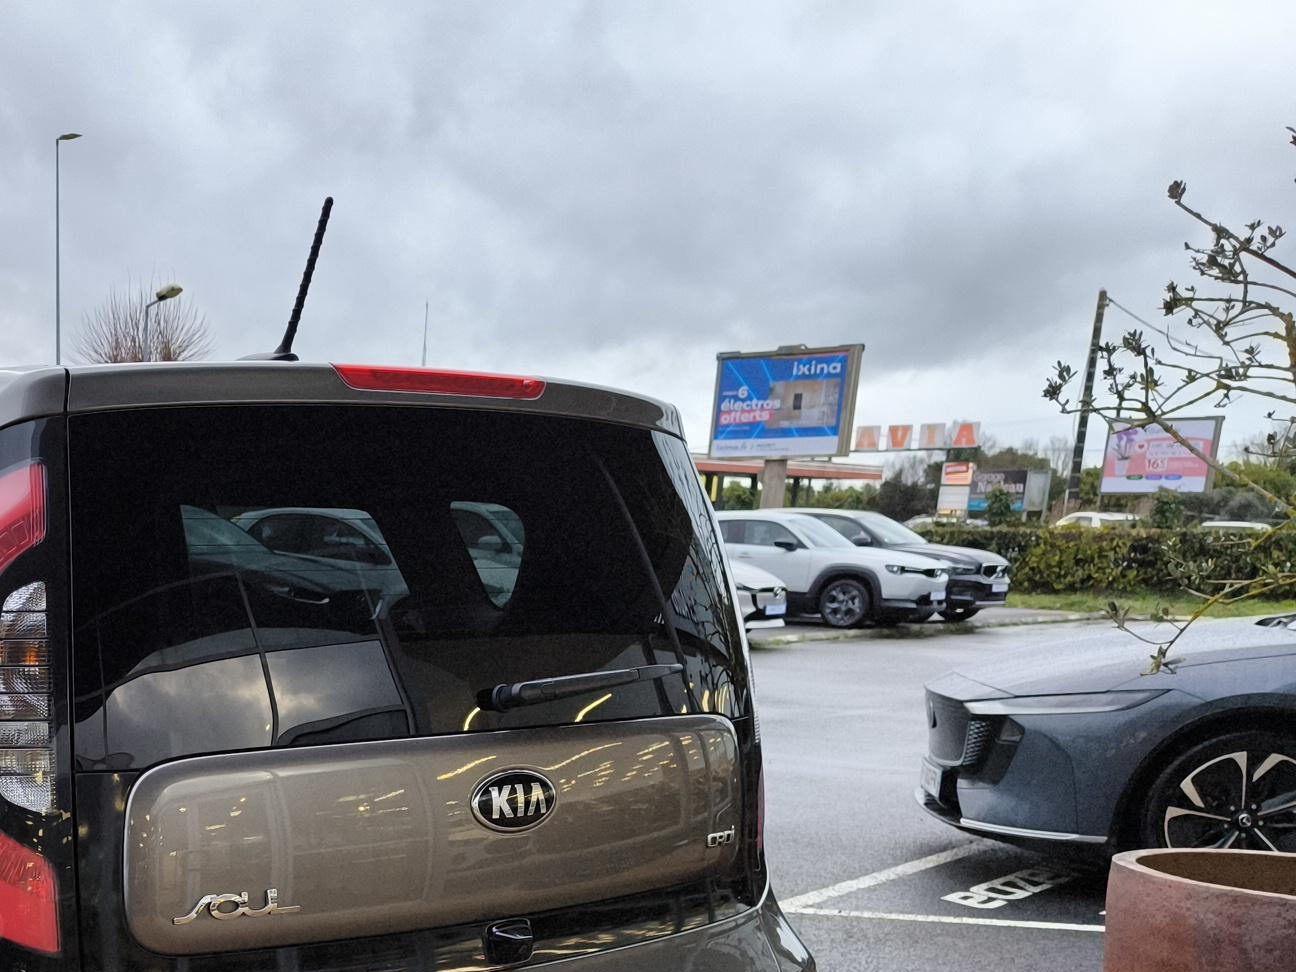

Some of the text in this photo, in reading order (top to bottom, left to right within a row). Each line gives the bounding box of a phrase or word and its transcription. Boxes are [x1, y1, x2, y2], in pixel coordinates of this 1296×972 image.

[792, 361, 842, 376] ixina
[737, 386, 749, 399] 6
[720, 398, 781, 411] électros
[720, 410, 771, 425] offerts
[854, 423, 976, 449] AVIA
[488, 782, 547, 819] KIA
